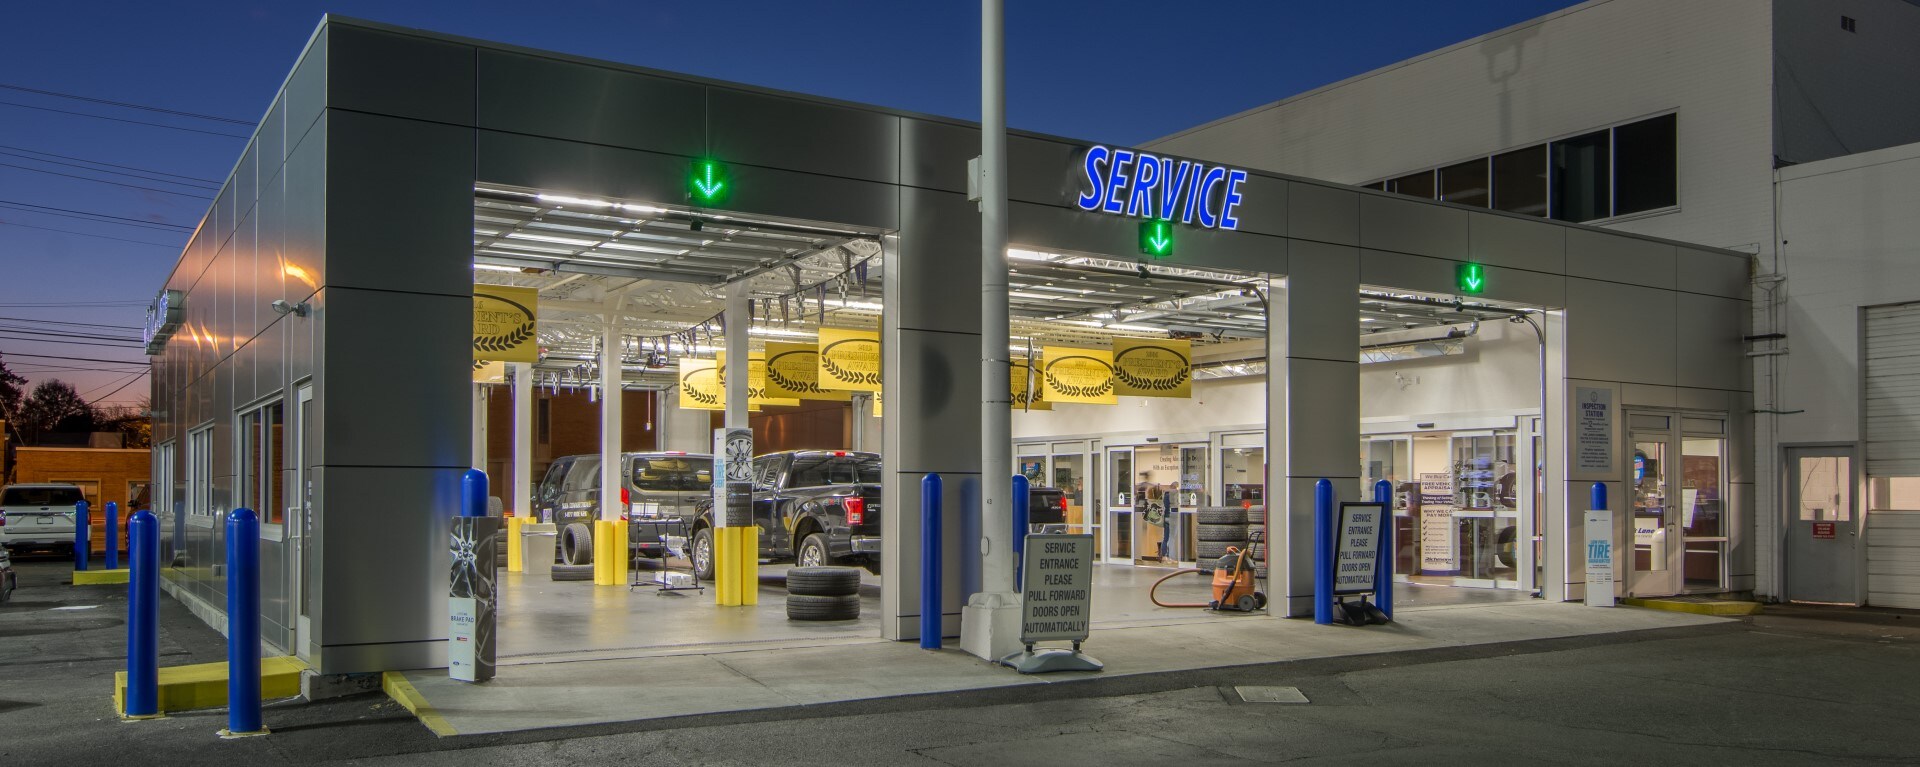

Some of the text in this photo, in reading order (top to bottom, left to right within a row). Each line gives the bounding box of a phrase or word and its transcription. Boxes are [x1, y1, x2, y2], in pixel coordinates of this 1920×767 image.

[1078, 145, 1248, 230] SERVICE
[1136, 369, 1169, 377] AWARD
[1352, 514, 1372, 522] SERVICE
[1348, 526, 1372, 535] ENTRANCE
[1045, 542, 1076, 554] SERVICE
[1351, 539, 1368, 547] PLEASE
[1340, 550, 1375, 560] PULL FORWARD
[1588, 544, 1610, 558] TIRE
[1040, 558, 1079, 569] ENTRANCE
[1342, 563, 1370, 572] DOORS OPEN
[1045, 574, 1072, 585] PLEASE
[1336, 575, 1374, 584] AUTOMATICALLY
[1028, 590, 1085, 601] PULL FORWARD
[1033, 606, 1079, 617] DOORS OPEN
[1024, 620, 1086, 634] AUTOMATICALLY
